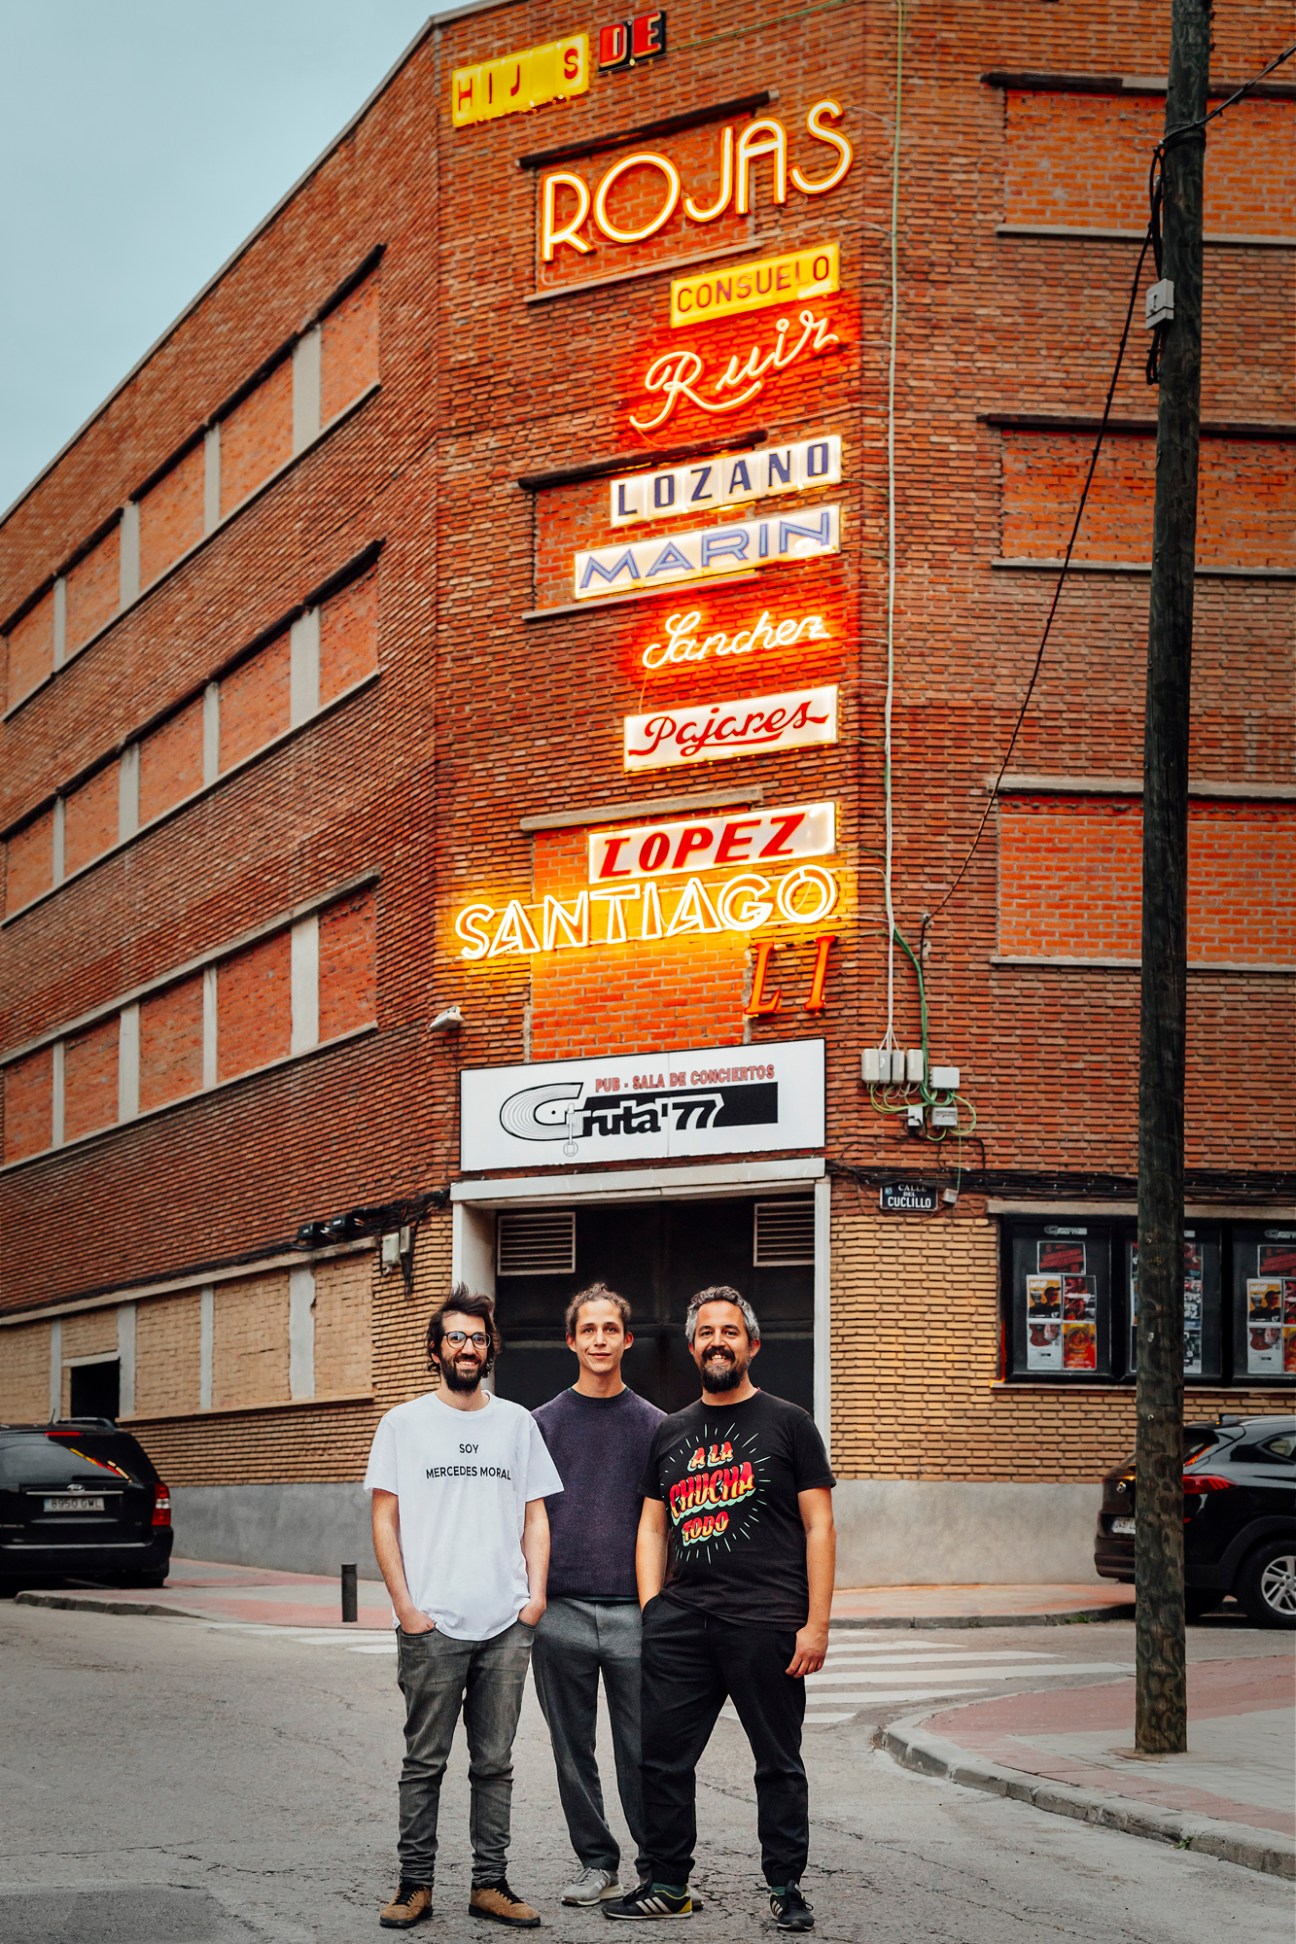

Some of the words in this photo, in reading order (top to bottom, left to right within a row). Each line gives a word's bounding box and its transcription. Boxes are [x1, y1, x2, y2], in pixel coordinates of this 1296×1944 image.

[599, 11, 662, 68] DE
[541, 98, 854, 262] ROJAS
[677, 255, 830, 313] CONSUELO
[617, 441, 830, 516] LOZANO
[579, 511, 831, 589] MARIN
[641, 610, 830, 670] Sanchez
[627, 700, 830, 757] Pajares
[599, 812, 806, 878] LOPEZ
[455, 864, 837, 960] SANTIAGO
[595, 1077, 621, 1093] PUB
[632, 1074, 666, 1090] SALA
[669, 1071, 687, 1087] DE
[690, 1063, 776, 1085] CONCIERTOS
[499, 1081, 720, 1141] Gruta'77
[887, 1196, 932, 1208] CUCLILLO
[897, 1184, 927, 1192] CALLE
[426, 1465, 478, 1480] MERCEDES
[480, 1466, 512, 1480] MORAL
[459, 1443, 479, 1454] SOY
[688, 1447, 706, 1471] A
[707, 1441, 734, 1467] LA
[669, 1461, 756, 1524] CHUCHA
[682, 1510, 730, 1546] TODO
